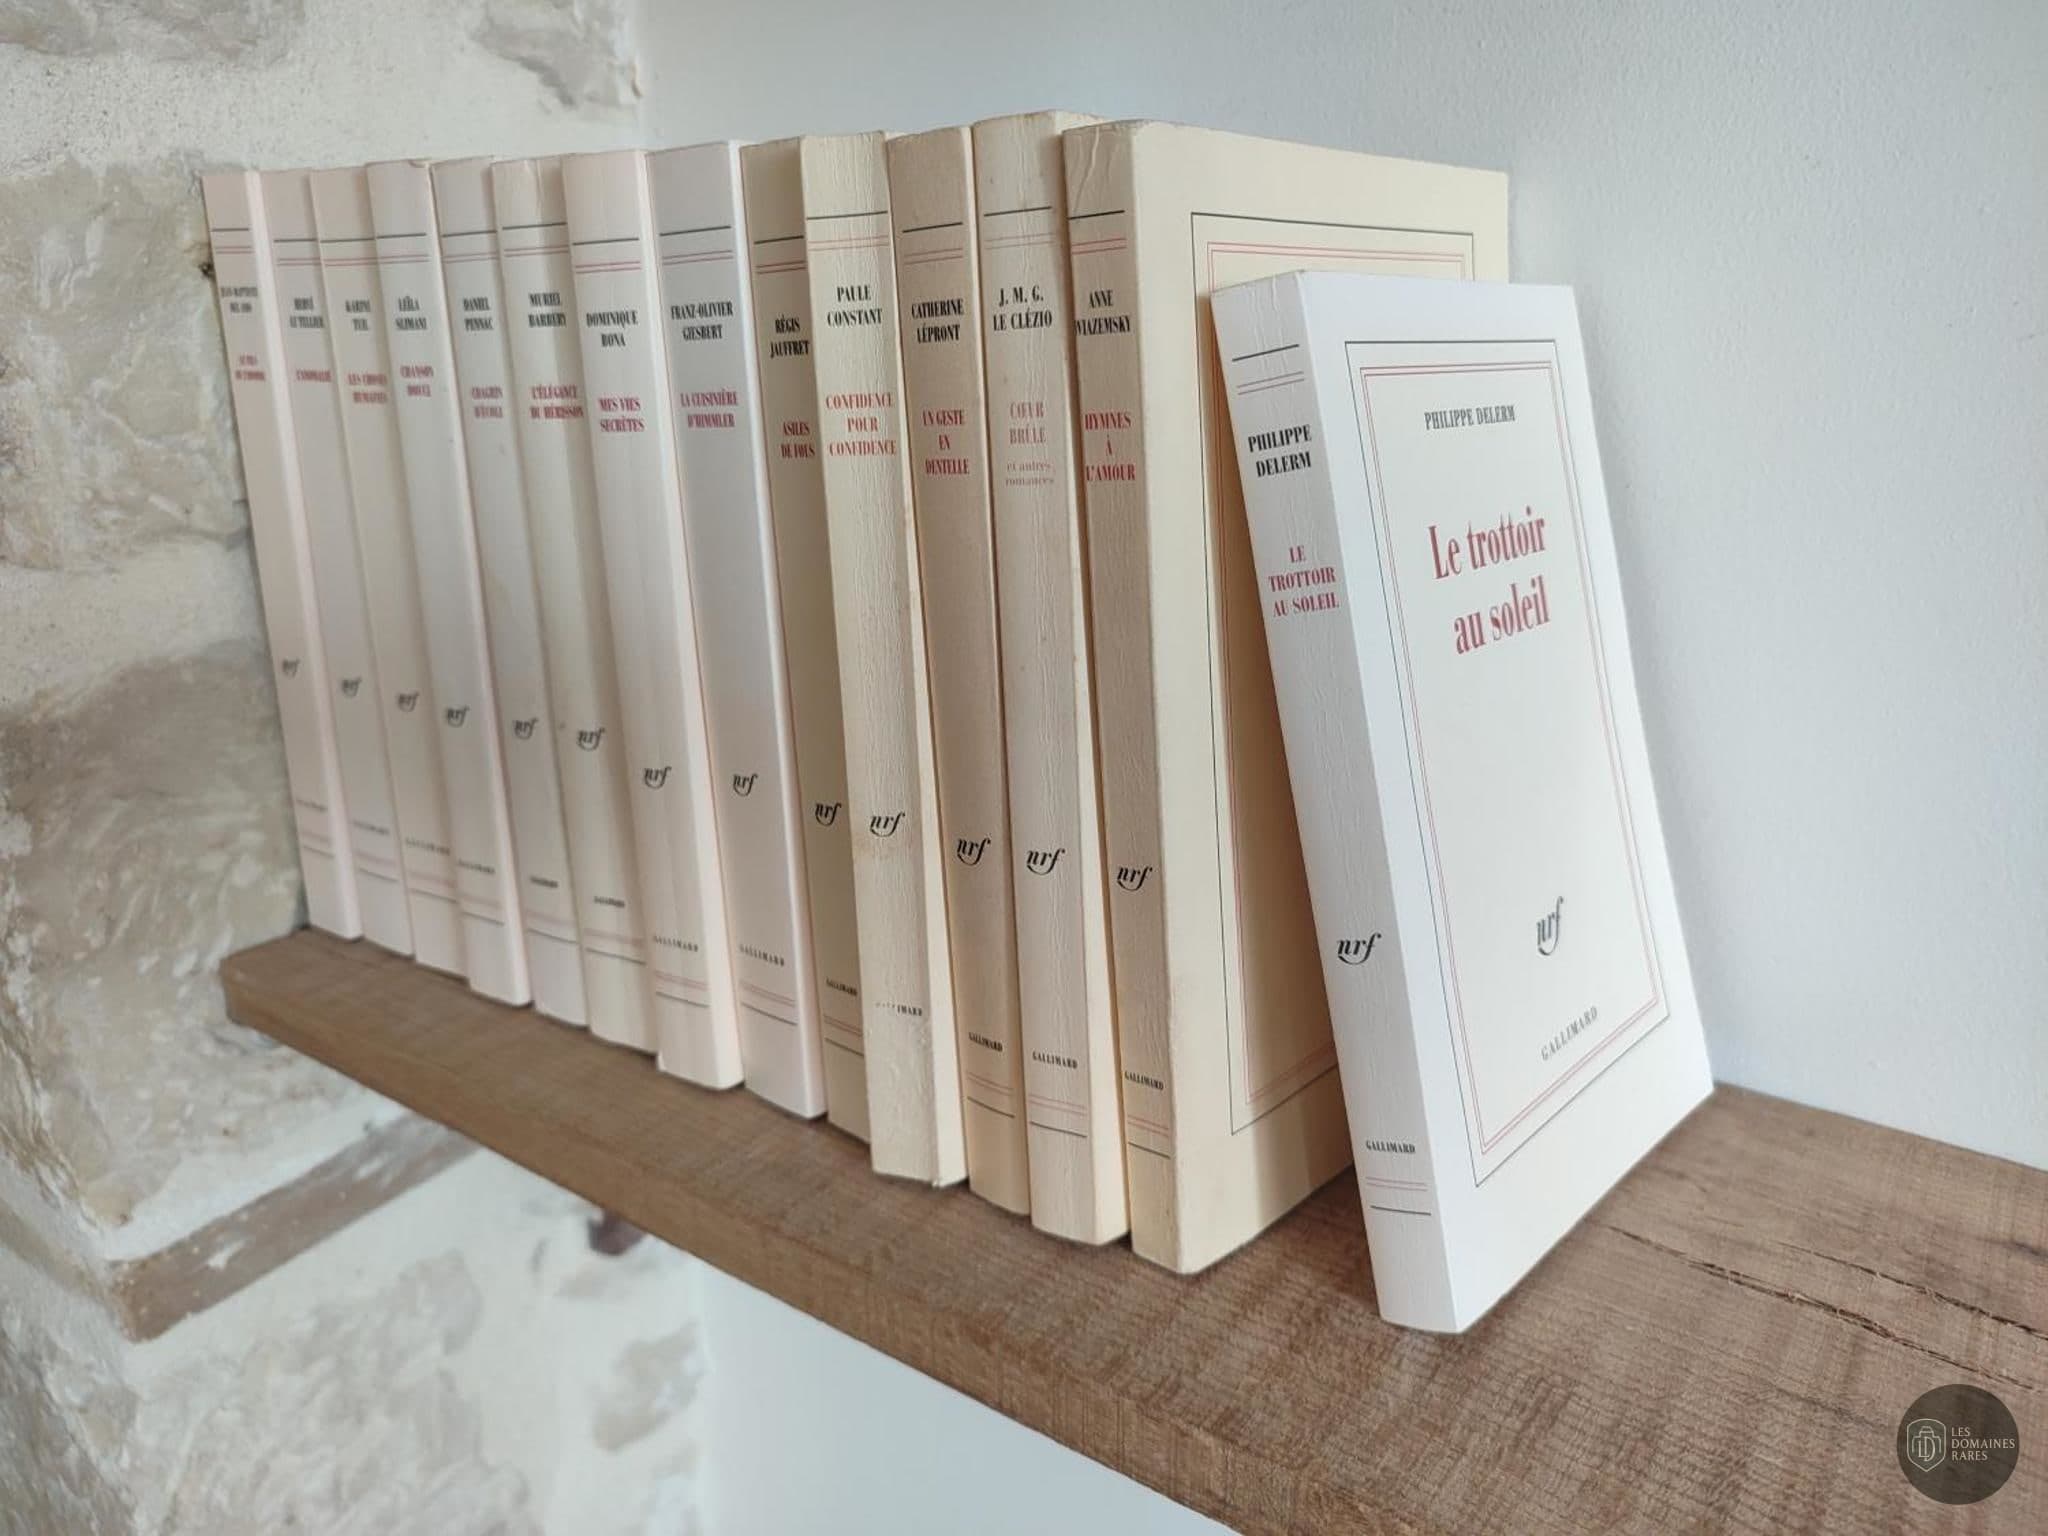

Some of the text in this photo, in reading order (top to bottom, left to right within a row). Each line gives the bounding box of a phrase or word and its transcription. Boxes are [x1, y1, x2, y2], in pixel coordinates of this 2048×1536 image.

[463, 296, 490, 312] DANIEL
[528, 292, 562, 307] MURIEL
[836, 285, 872, 303] PAULE
[998, 285, 1044, 307] J. M. G.
[1088, 290, 1114, 309] ANNE
[670, 300, 734, 320] FRANZ-OLIVIER
[827, 308, 883, 327] CONSTANT
[911, 298, 964, 320] CATHERINE
[464, 317, 494, 331] PENNAC
[528, 313, 567, 328] BARBERY
[586, 310, 639, 329] DOMINIQUE
[774, 314, 801, 334] RÉGIS
[992, 308, 1053, 332] LE CLÉZIO
[600, 332, 626, 348] BONA
[682, 324, 724, 341] GIESBERT
[916, 324, 961, 344] LÉPRONT
[770, 340, 811, 358] JAUFFRET
[598, 396, 641, 412] MES VIES
[680, 388, 738, 408] LA CUISINIÈRE
[826, 391, 894, 410] CONFIDENCE
[530, 406, 542, 420] DU
[687, 412, 736, 428] D'HIMMLER
[922, 409, 965, 426] UN GESTE
[1084, 412, 1132, 431] HYMNES
[1424, 405, 1516, 431] PHILIPPE DELERM
[600, 416, 645, 433] SECRÈTES
[782, 420, 810, 436] ASILES
[846, 416, 880, 433] POUR
[829, 439, 897, 457] CONFIDENCE
[938, 434, 951, 450] EN
[1105, 434, 1114, 457] À
[1247, 424, 1313, 453] PHILIPPE
[780, 442, 816, 458] DE FOUS
[924, 458, 970, 476] DENTELLE
[1006, 461, 1050, 472] et autres
[1086, 463, 1136, 483] L'AMOUR
[1255, 452, 1312, 478] DELERM
[1428, 505, 1546, 580] Le trottoir
[1288, 544, 1307, 565] LE
[1268, 566, 1336, 593] TROTTOIR
[1272, 592, 1340, 618] AU SOLEIL
[1453, 574, 1551, 655] au soleil
[576, 726, 606, 751] nrf
[644, 766, 672, 790] nrf
[732, 773, 758, 797] nrf
[814, 802, 842, 827] nrf
[870, 812, 906, 838] nrf
[956, 836, 992, 866] nrf
[1026, 848, 1066, 876] nrf
[1117, 866, 1153, 892] nrf
[1536, 895, 1564, 956] nrf
[1336, 932, 1382, 966] nrf
[968, 1031, 1004, 1052] GALLIMARD
[1540, 1005, 1599, 1062] GALLIMARD
[1032, 1050, 1079, 1070] GALLIMARD
[1124, 1070, 1165, 1092] GALLIMARD
[1365, 1139, 1416, 1155] GALLIMARD
